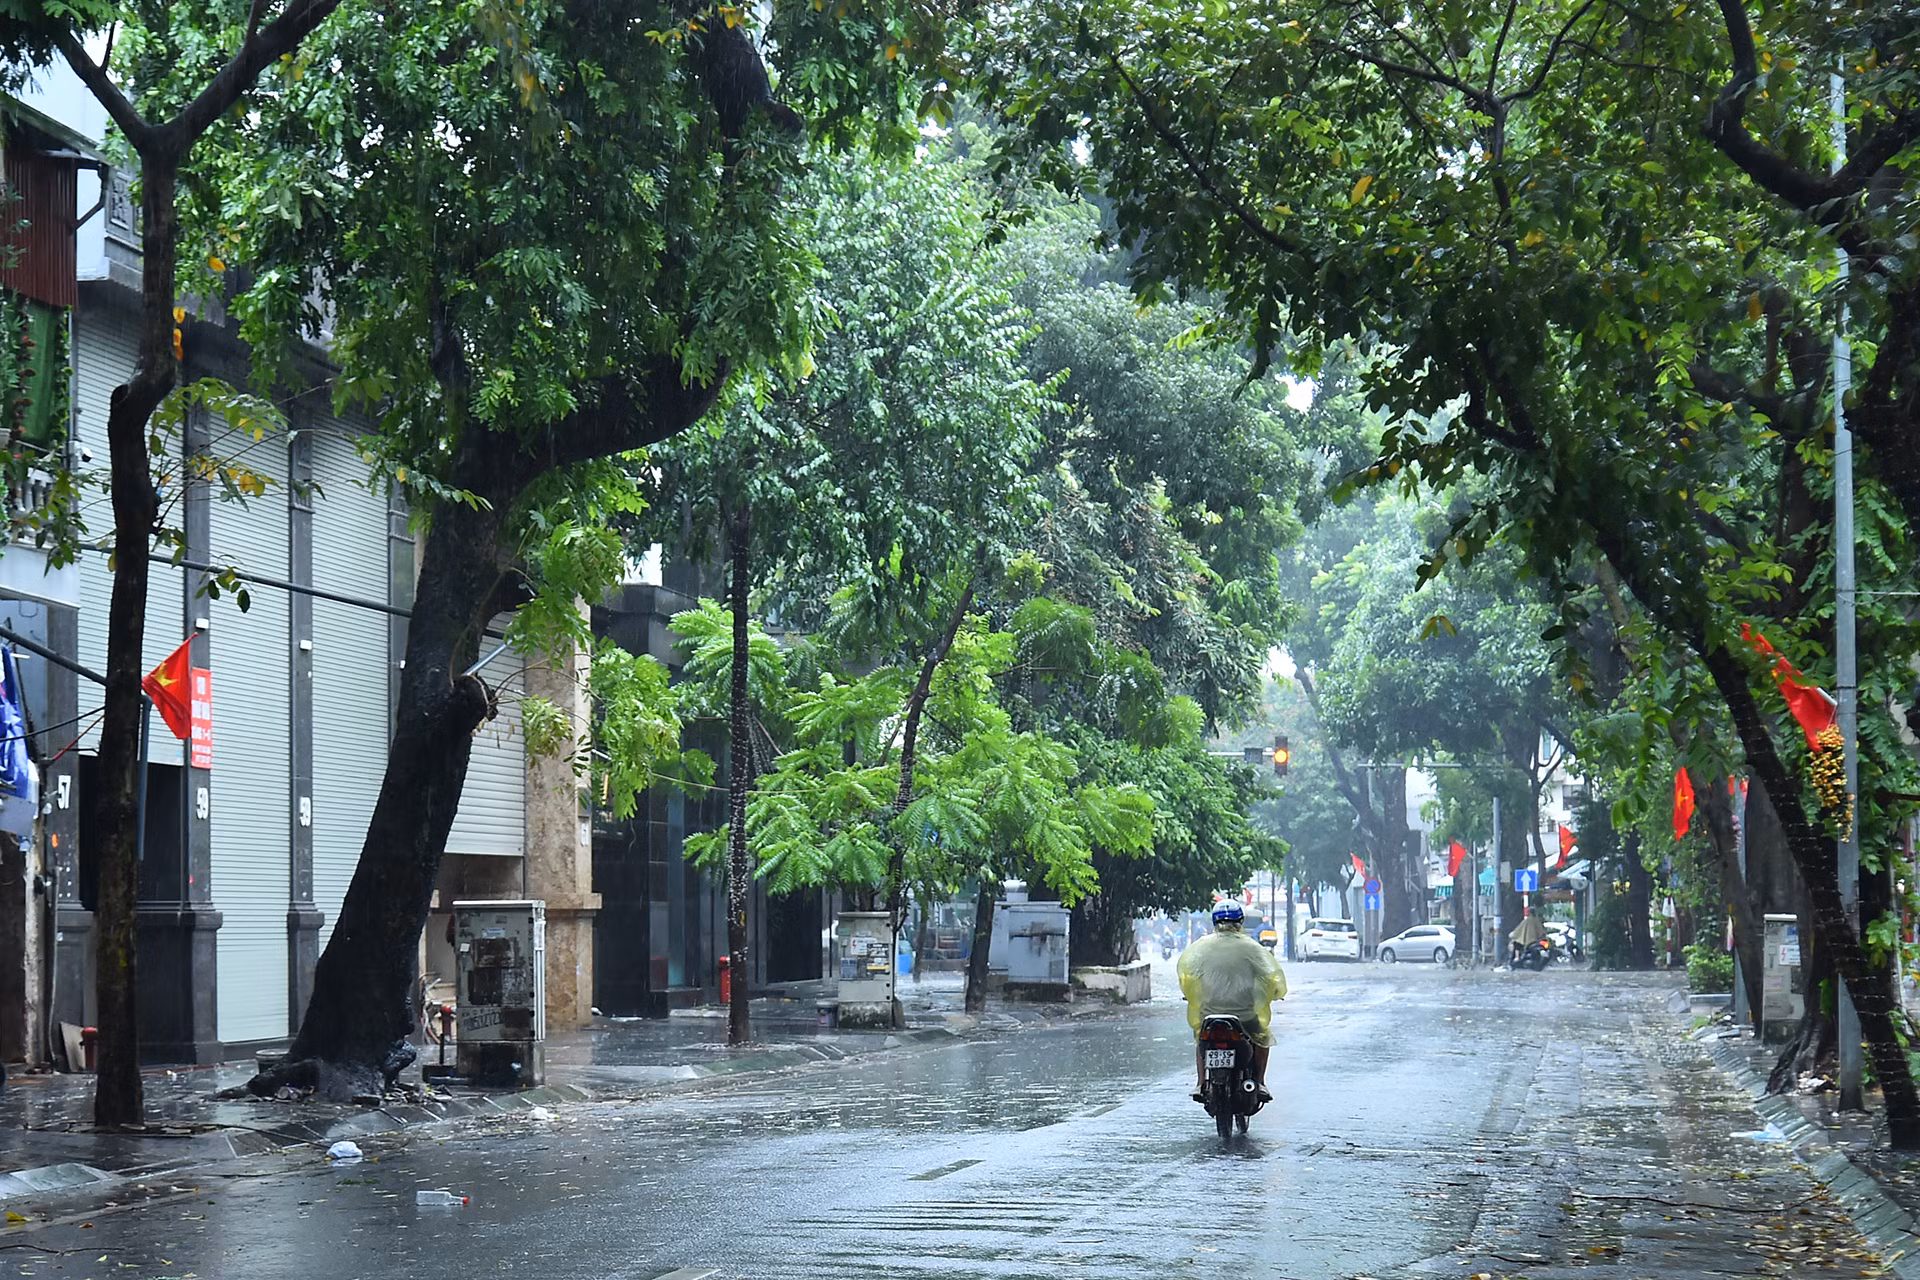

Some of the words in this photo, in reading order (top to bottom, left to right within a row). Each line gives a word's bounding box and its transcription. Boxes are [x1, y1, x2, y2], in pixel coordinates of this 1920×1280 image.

[58, 775, 71, 809] 57
[196, 787, 208, 819] 59
[300, 796, 311, 826] 59
